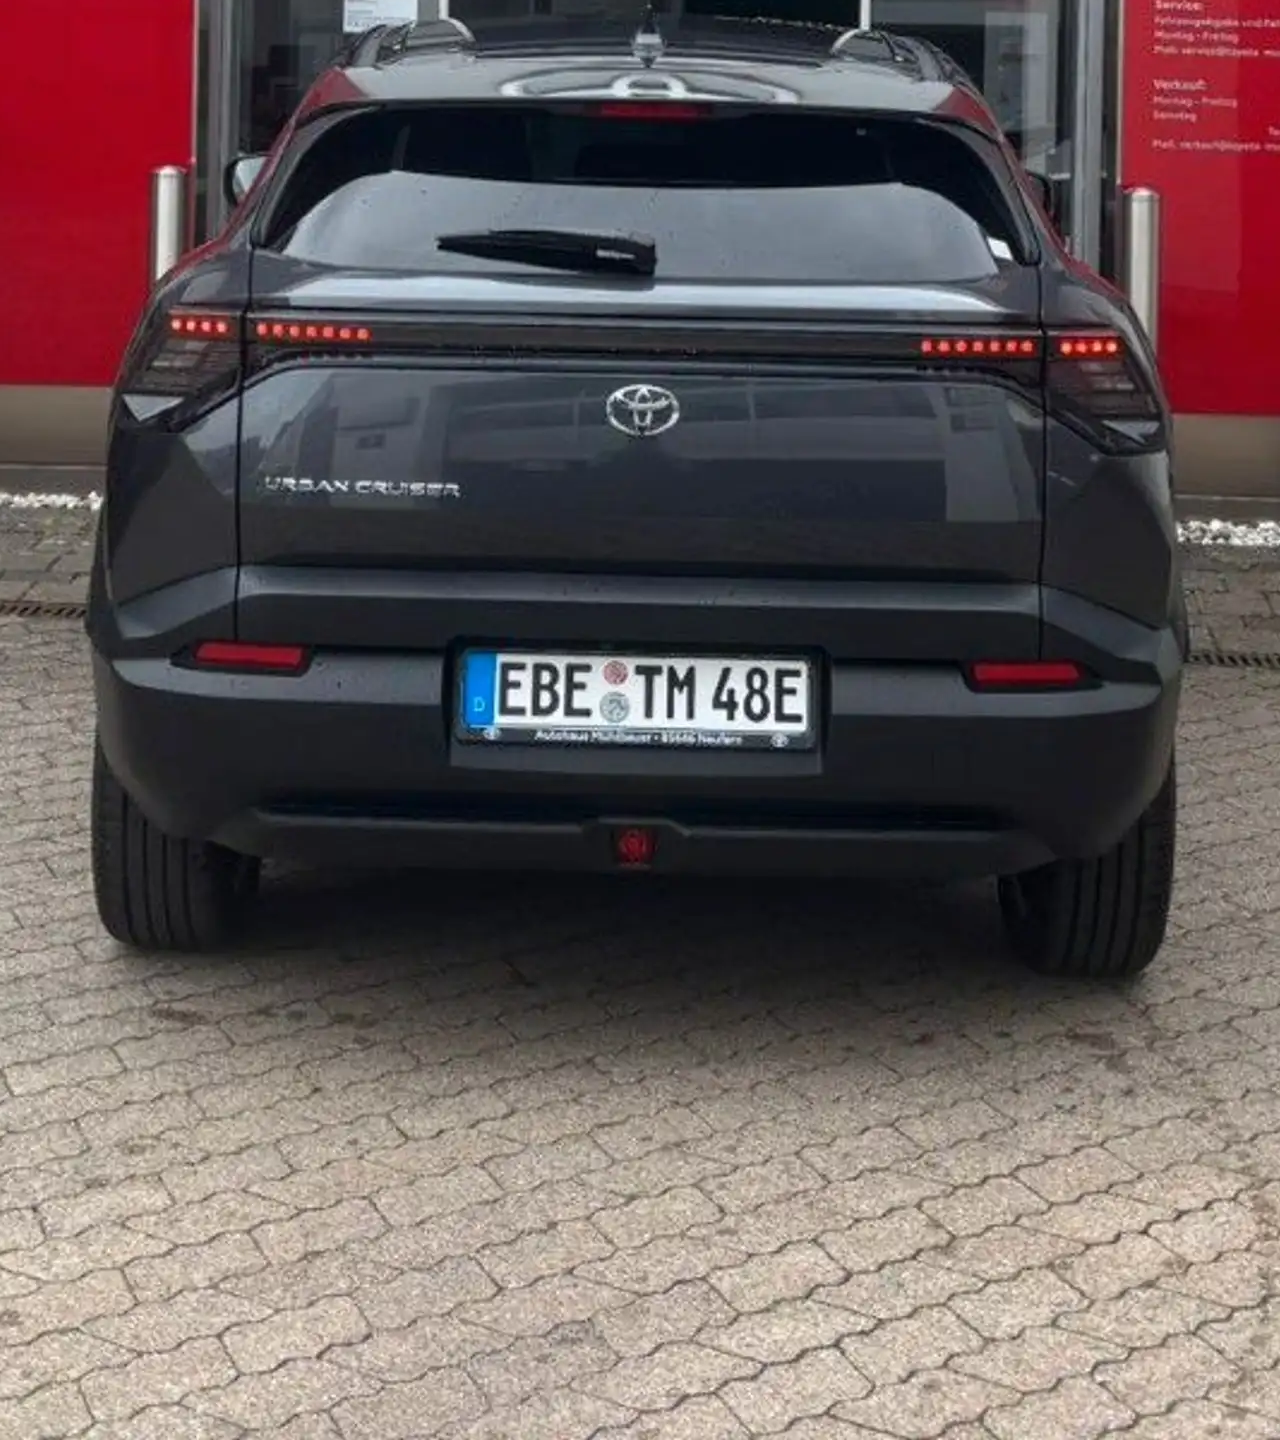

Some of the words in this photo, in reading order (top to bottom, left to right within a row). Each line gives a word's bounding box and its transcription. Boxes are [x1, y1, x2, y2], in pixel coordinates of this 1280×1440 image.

[265, 475, 349, 493] URBAN
[355, 479, 461, 498] CRUISER
[498, 661, 593, 719] EBE
[635, 664, 697, 721] TM
[711, 666, 804, 724] 48E
[534, 729, 588, 743] Autohaus
